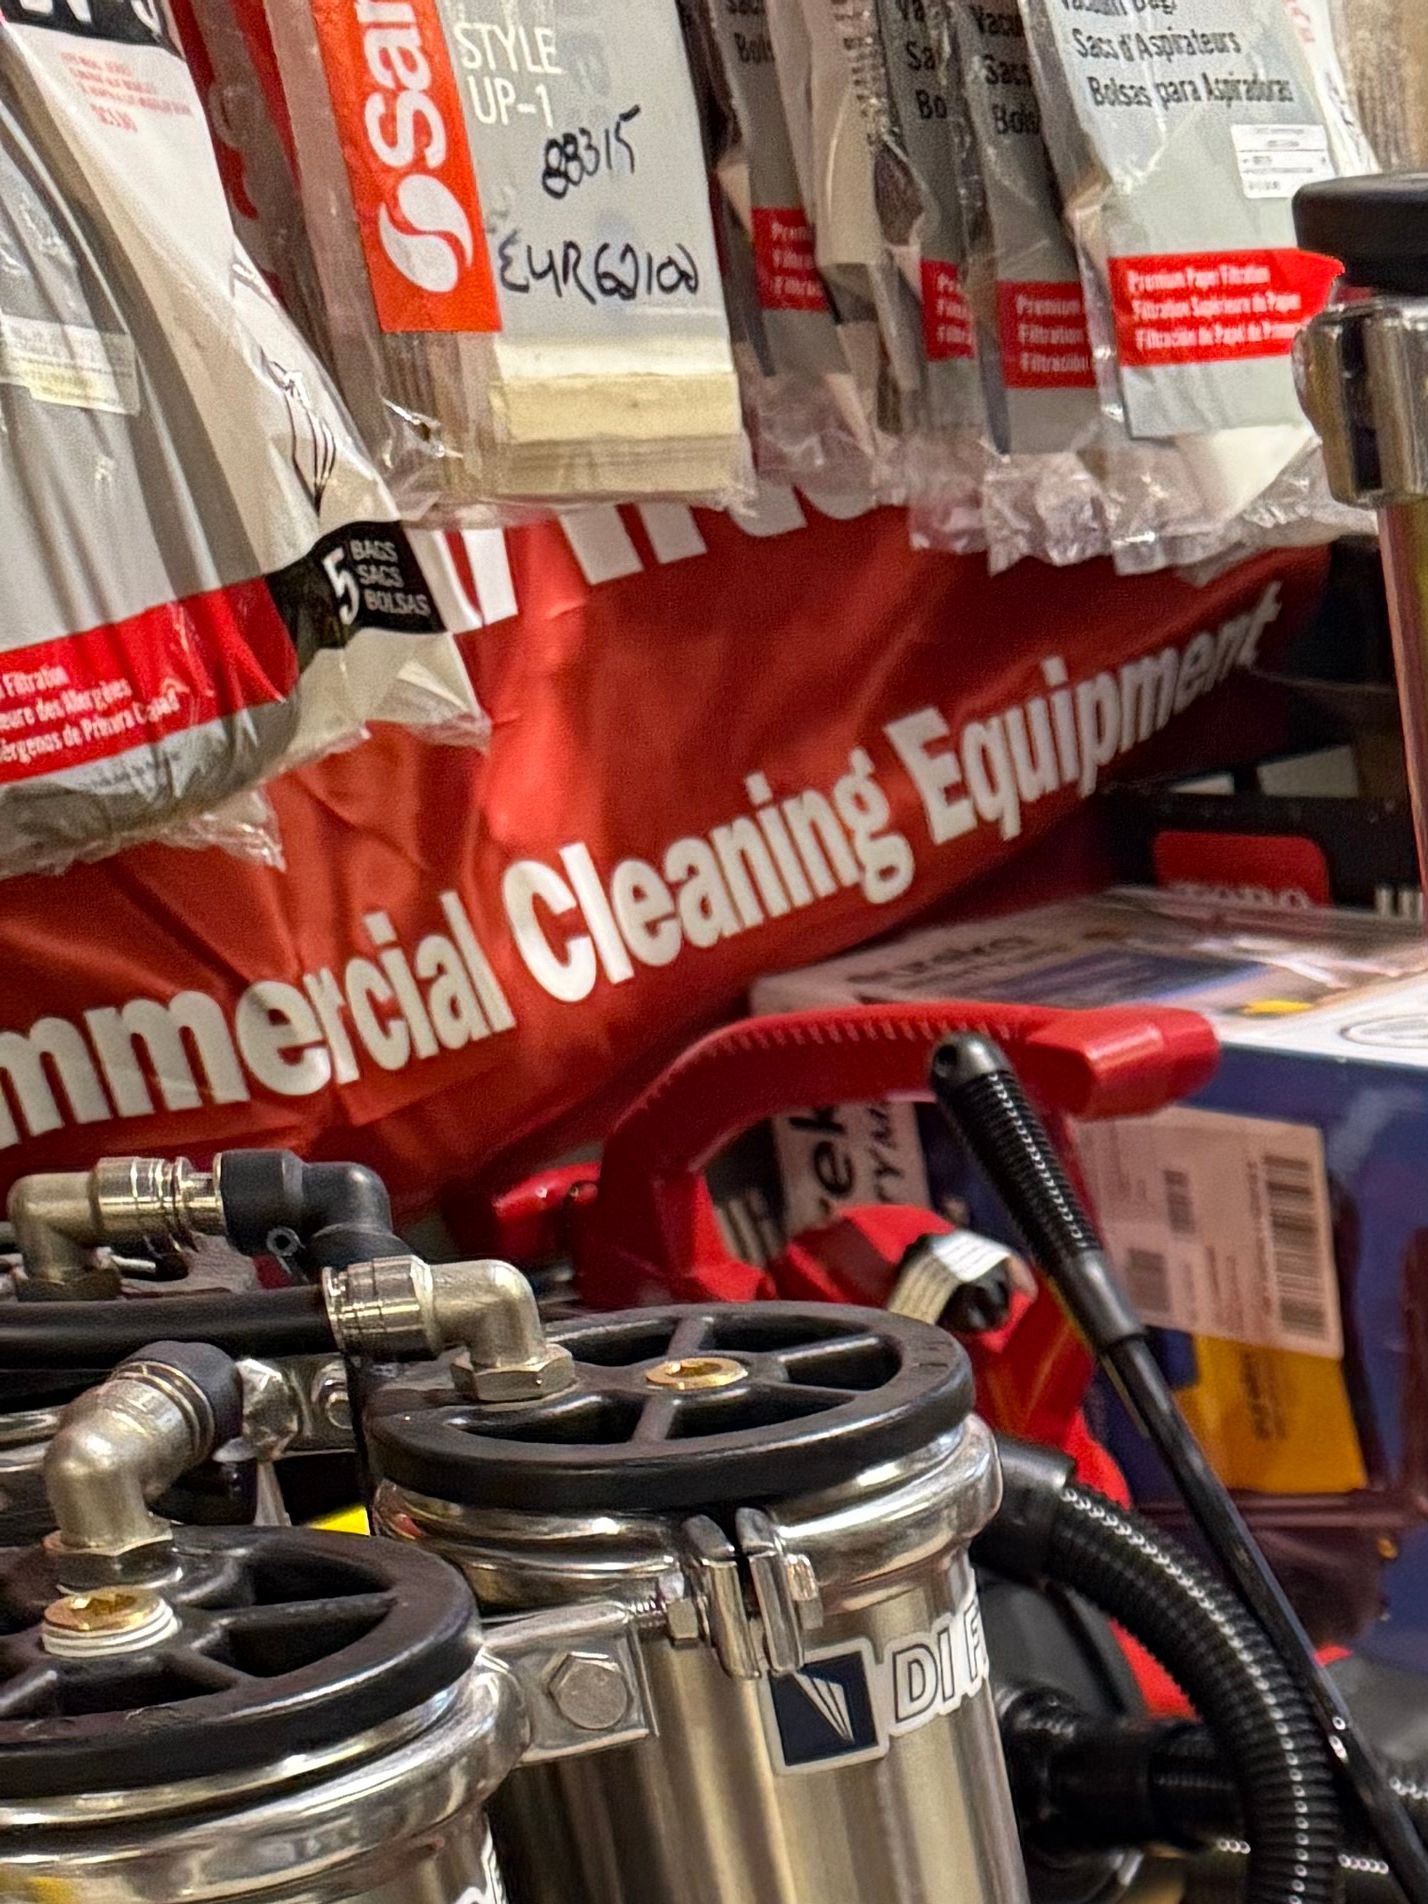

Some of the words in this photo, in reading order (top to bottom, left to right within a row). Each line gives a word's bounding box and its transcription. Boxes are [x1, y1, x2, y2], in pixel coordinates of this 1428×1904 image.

[454, 22, 566, 75] STYLE
[469, 76, 553, 129] UP-1
[350, 538, 398, 563] BAGS
[323, 548, 360, 626] 5
[364, 588, 431, 617] BOLSAS
[500, 749, 914, 1003] Cleaning
[884, 580, 1282, 848] Equipment
[892, 1626, 956, 1724] DI
